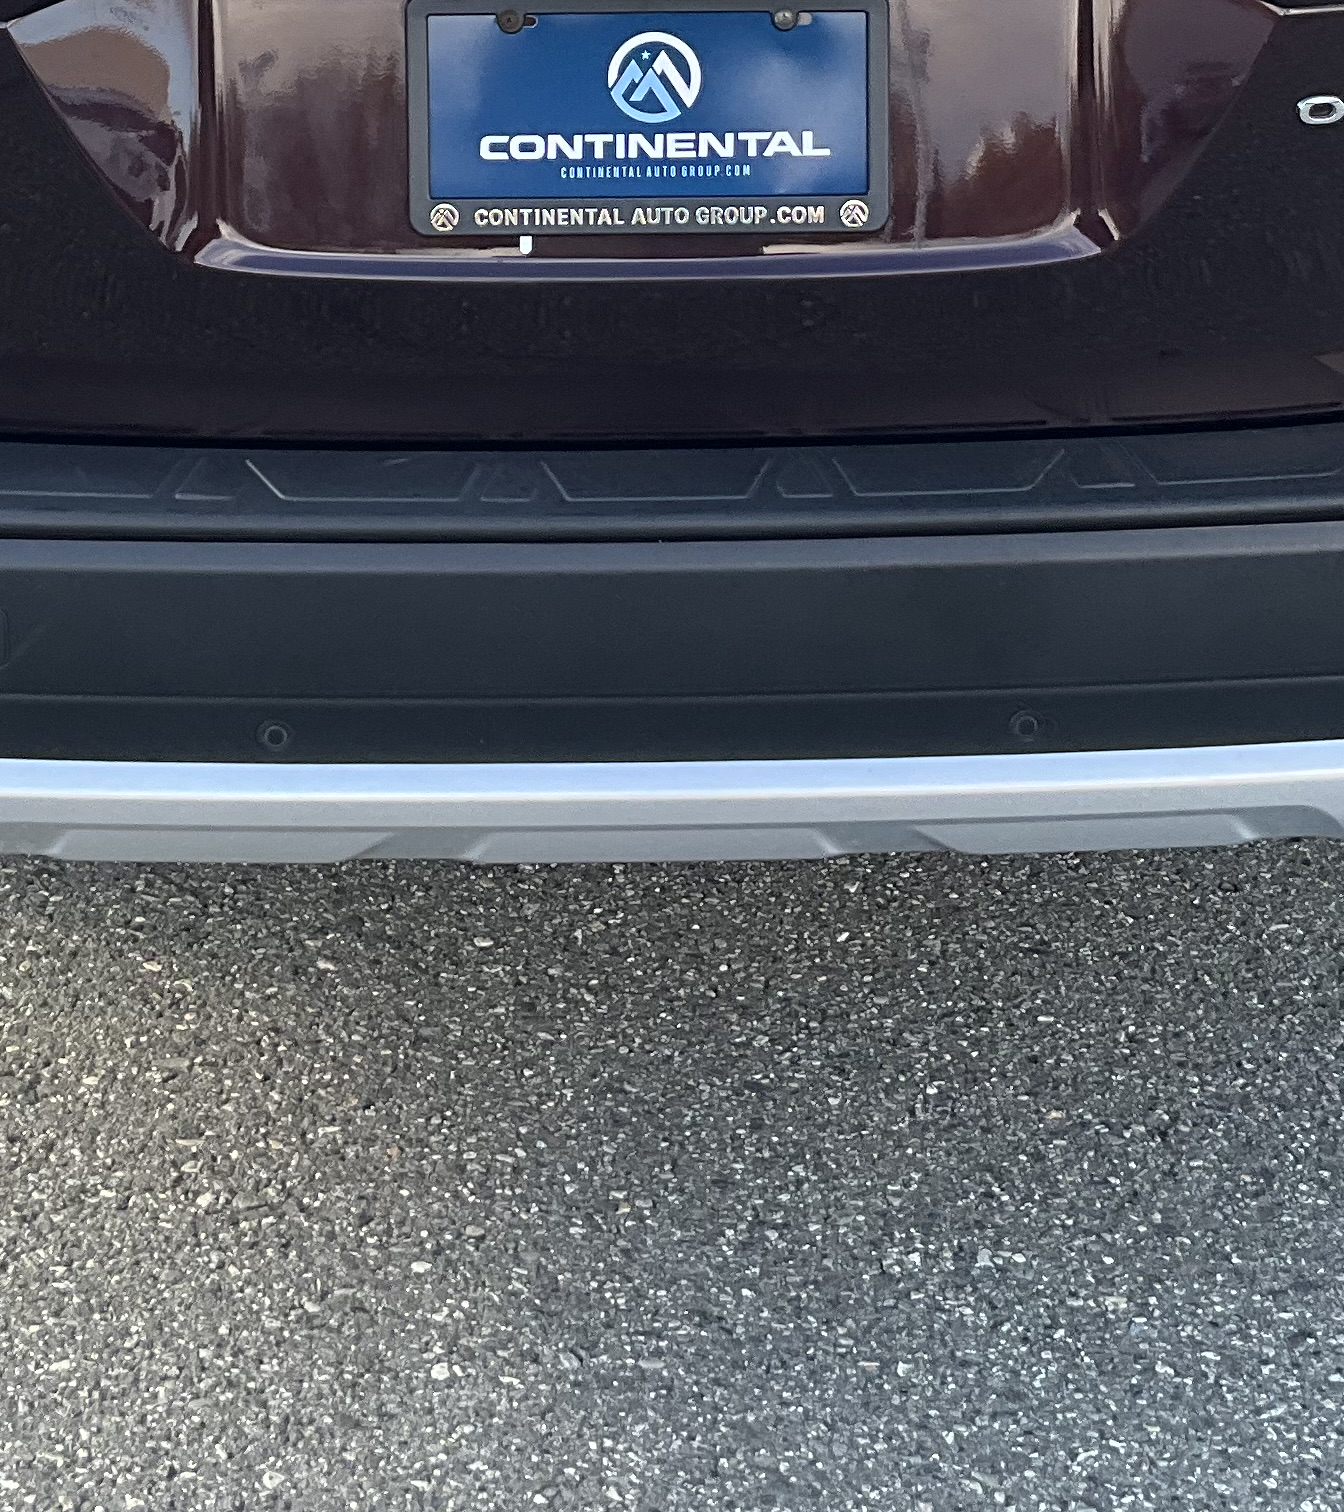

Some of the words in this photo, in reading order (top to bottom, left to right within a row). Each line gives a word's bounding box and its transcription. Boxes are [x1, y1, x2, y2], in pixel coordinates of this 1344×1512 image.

[479, 130, 831, 161] CONTINENTAL
[560, 166, 642, 179] CONTINENTAL
[646, 165, 677, 178] AUTO
[474, 207, 625, 226] CONTINENTAL
[631, 207, 690, 225] AUTO
